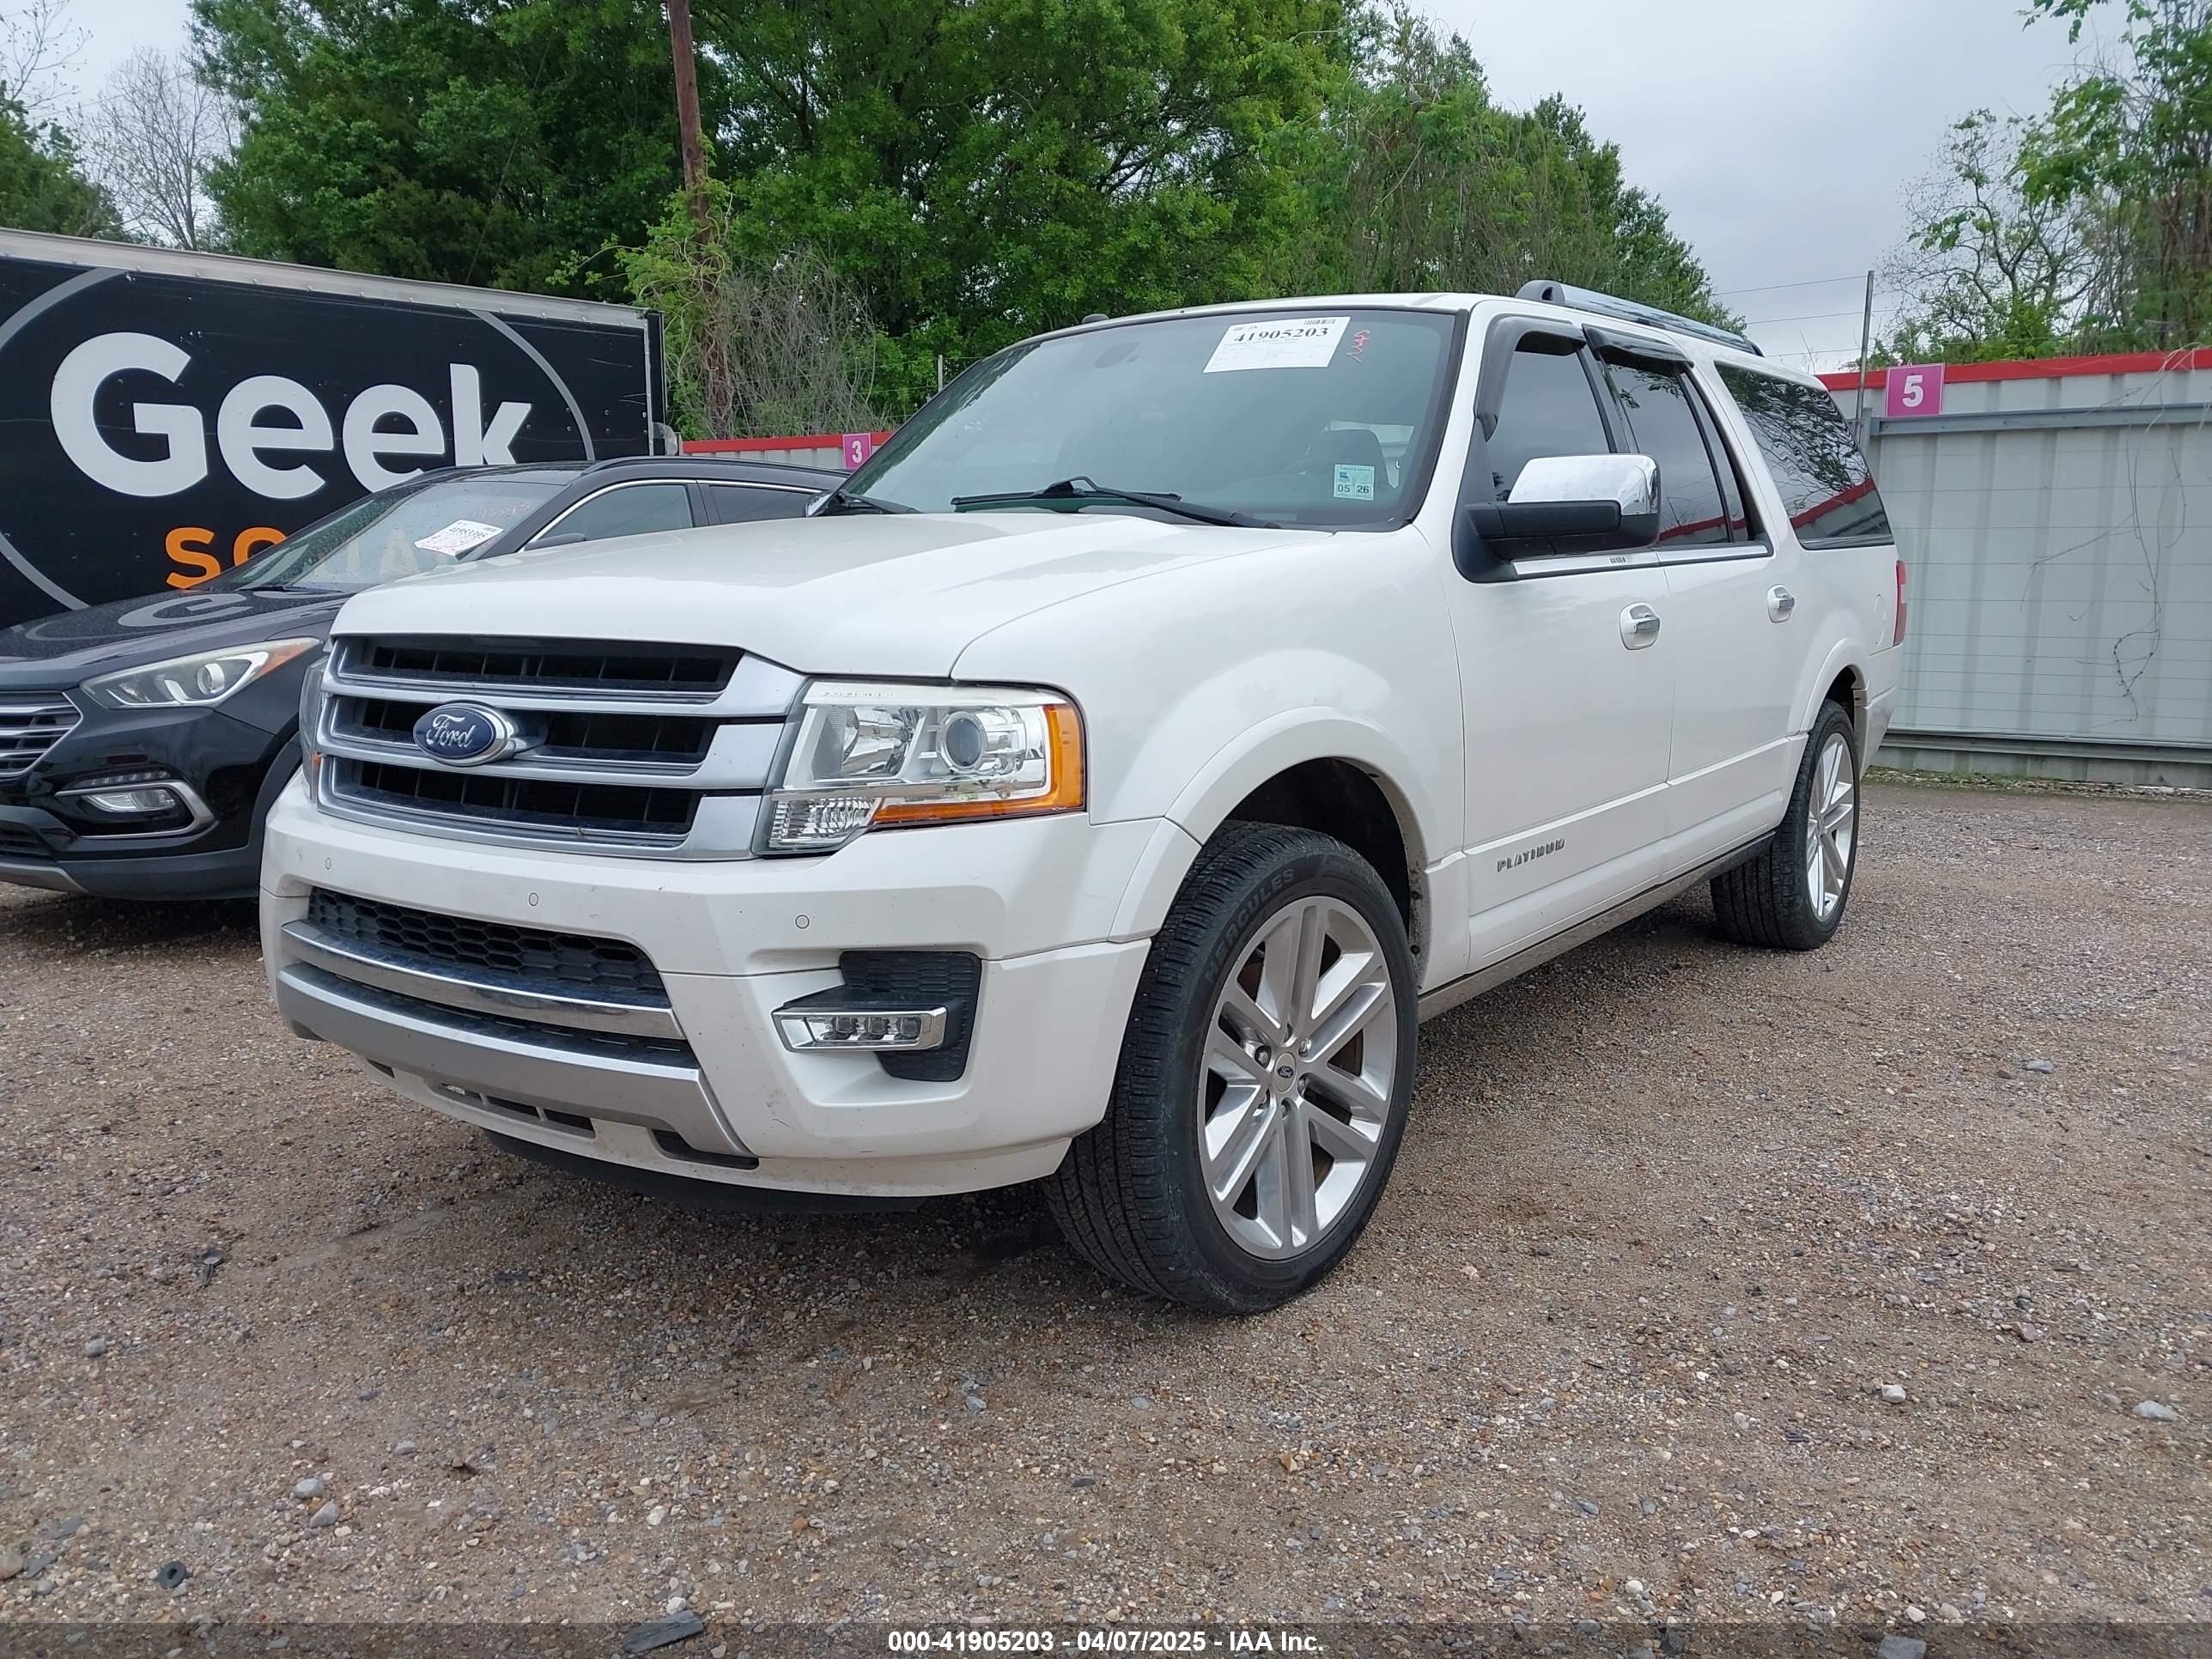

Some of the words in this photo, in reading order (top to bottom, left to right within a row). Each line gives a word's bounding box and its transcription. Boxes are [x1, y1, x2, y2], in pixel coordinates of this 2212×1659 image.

[1233, 326, 1329, 343] 41905203
[1902, 374, 1924, 407] 5
[51, 331, 532, 499] Geek
[851, 440, 863, 464] 3
[1337, 483, 1351, 493] 05
[1357, 484, 1370, 494] 26
[425, 714, 477, 748] Ford
[1497, 837, 1565, 872] PLATINUM
